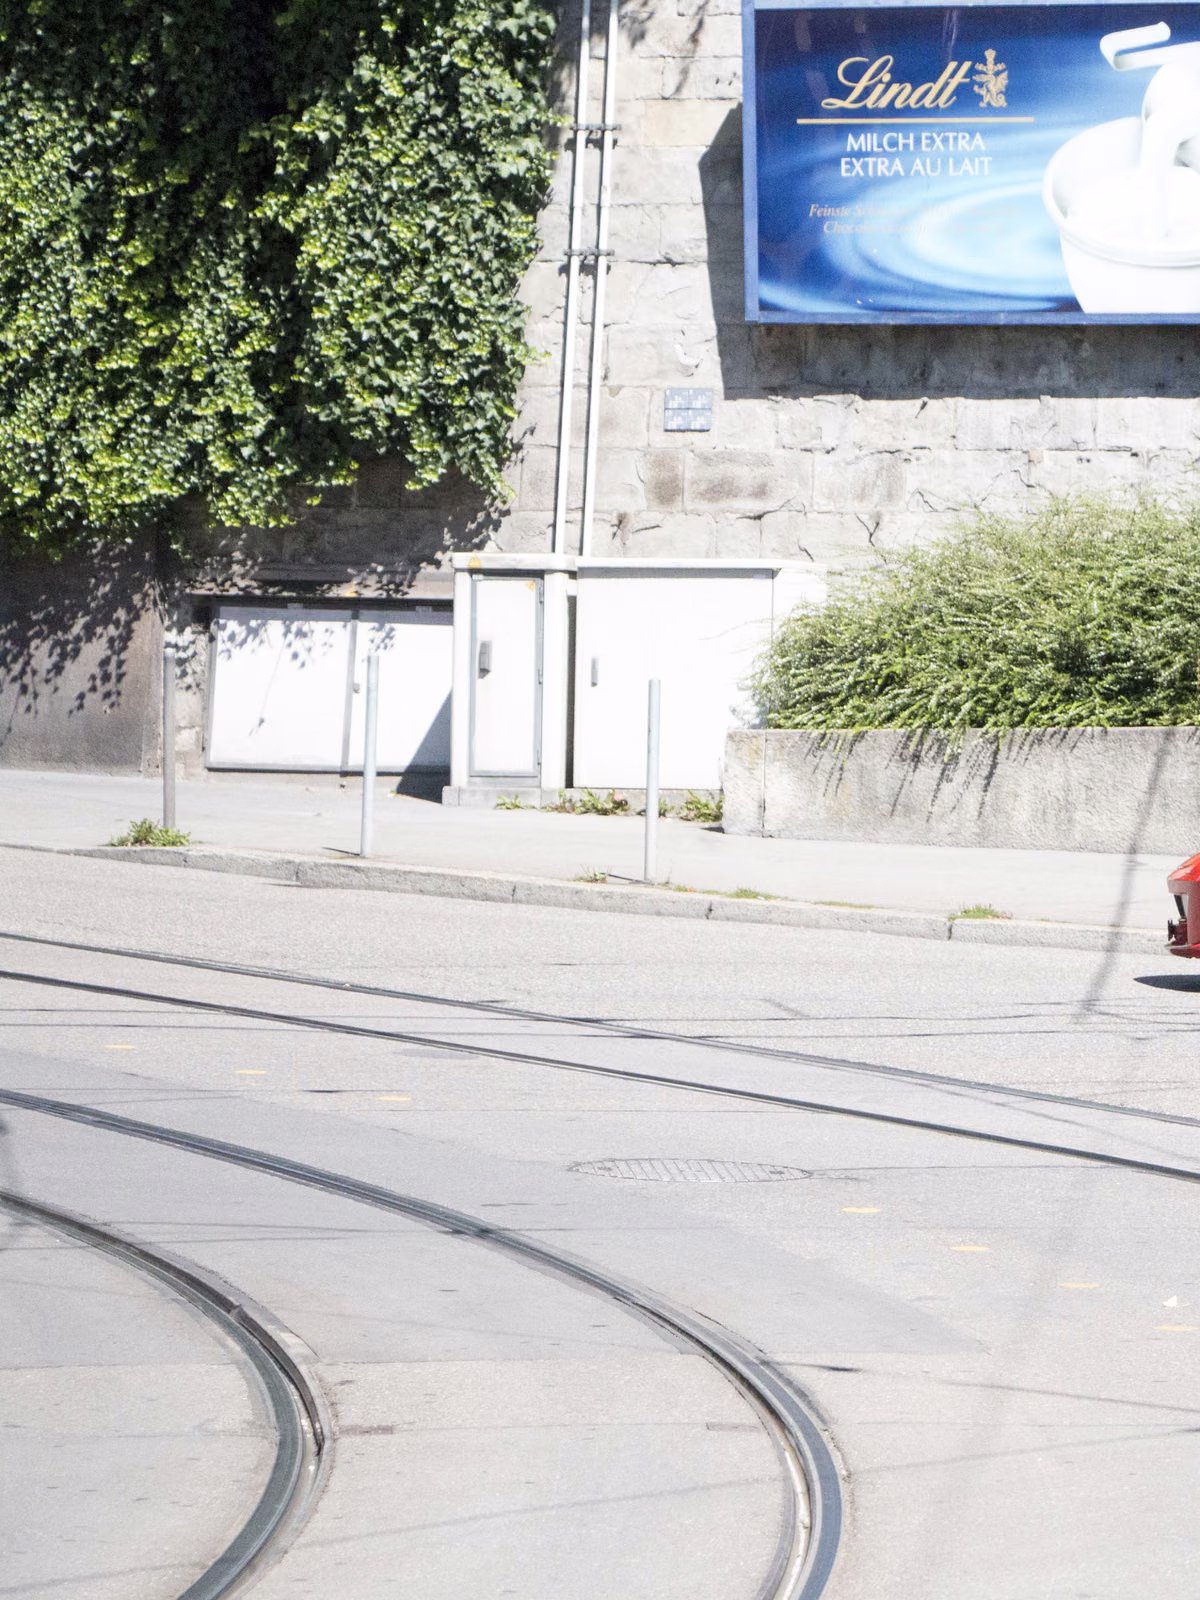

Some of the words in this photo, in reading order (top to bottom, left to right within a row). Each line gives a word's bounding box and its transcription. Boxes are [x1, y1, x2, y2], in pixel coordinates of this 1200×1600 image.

[821, 55, 972, 109] Lindt
[847, 132, 914, 152] MILCH
[921, 132, 986, 152] EXTRA
[841, 157, 904, 177] EXTRA
[910, 157, 941, 177] AU
[949, 157, 993, 177] LAIT
[809, 203, 850, 218] Feinste
